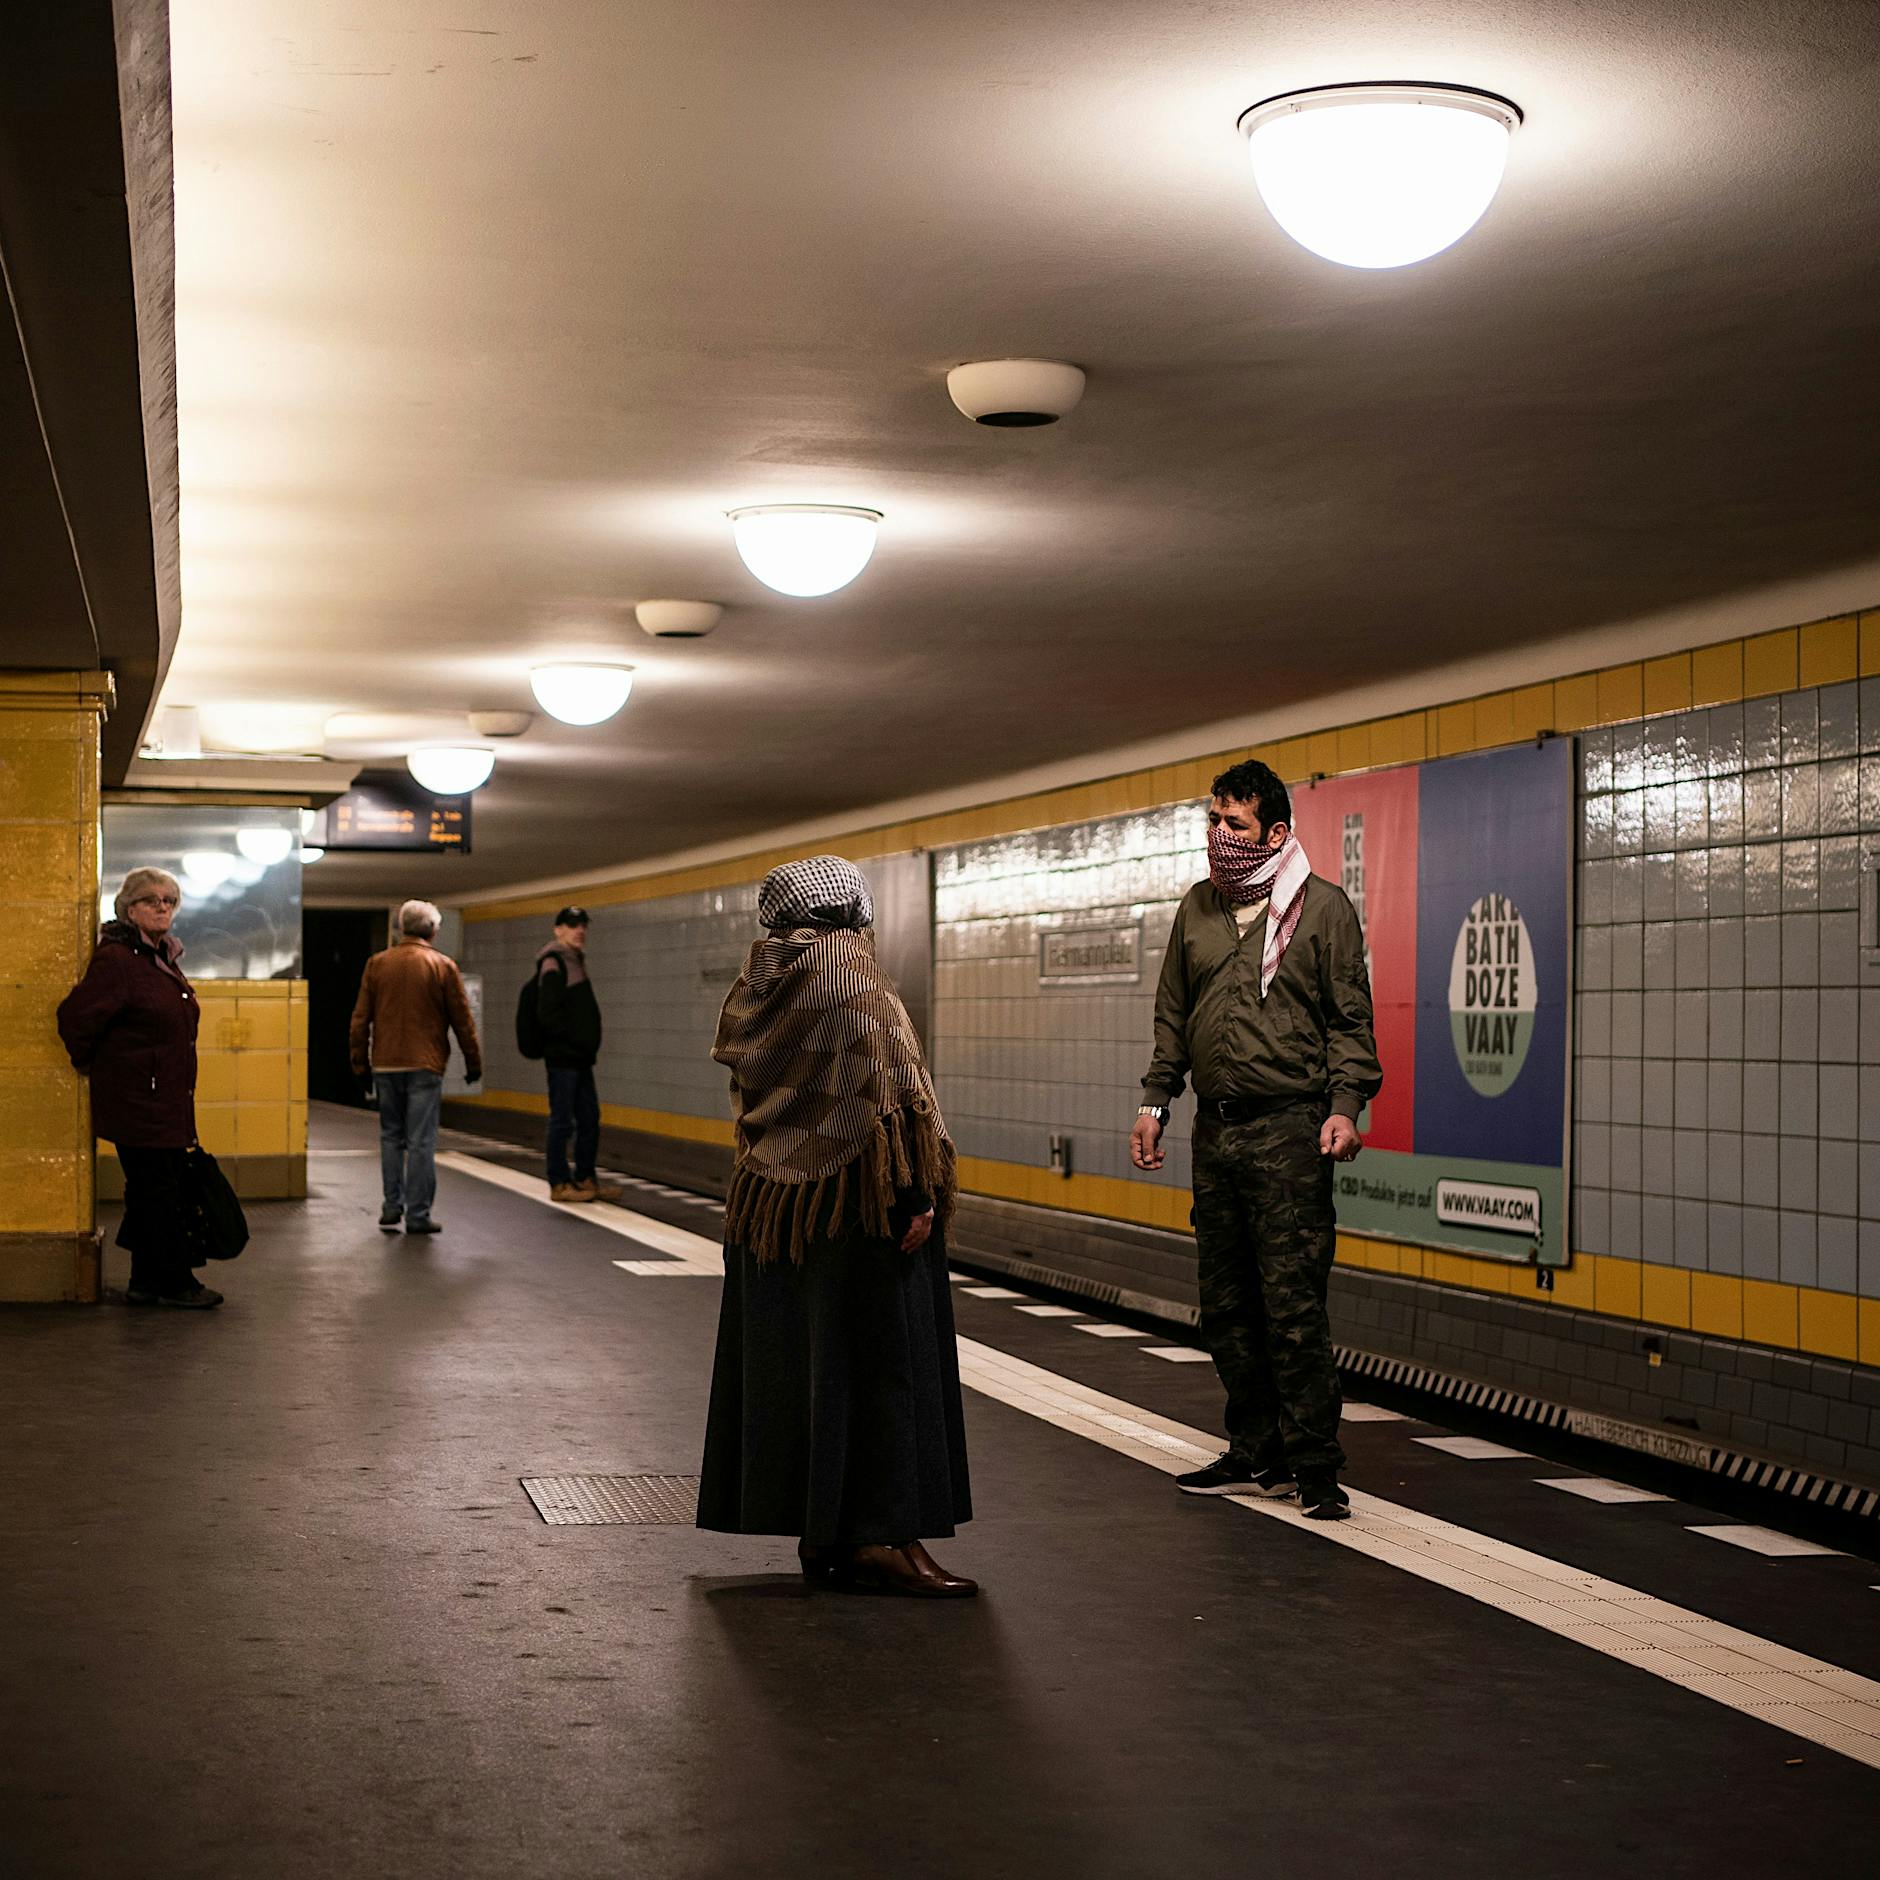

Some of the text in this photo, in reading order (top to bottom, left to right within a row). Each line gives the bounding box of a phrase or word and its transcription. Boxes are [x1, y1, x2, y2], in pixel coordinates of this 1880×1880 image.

[1467, 892, 1520, 924] AR
[1465, 924, 1520, 966] BATH
[1464, 967, 1519, 1008] DOZE
[1464, 1014, 1518, 1055] VAAY
[1340, 1175, 1359, 1196] CBD
[1360, 1178, 1395, 1203] Produkte
[1418, 1185, 1433, 1209] auf
[1442, 1191, 1535, 1221] WWW.VAAY.COM
[1541, 1270, 1549, 1290] 2
[1575, 1413, 1649, 1452] HALTEBEREICH
